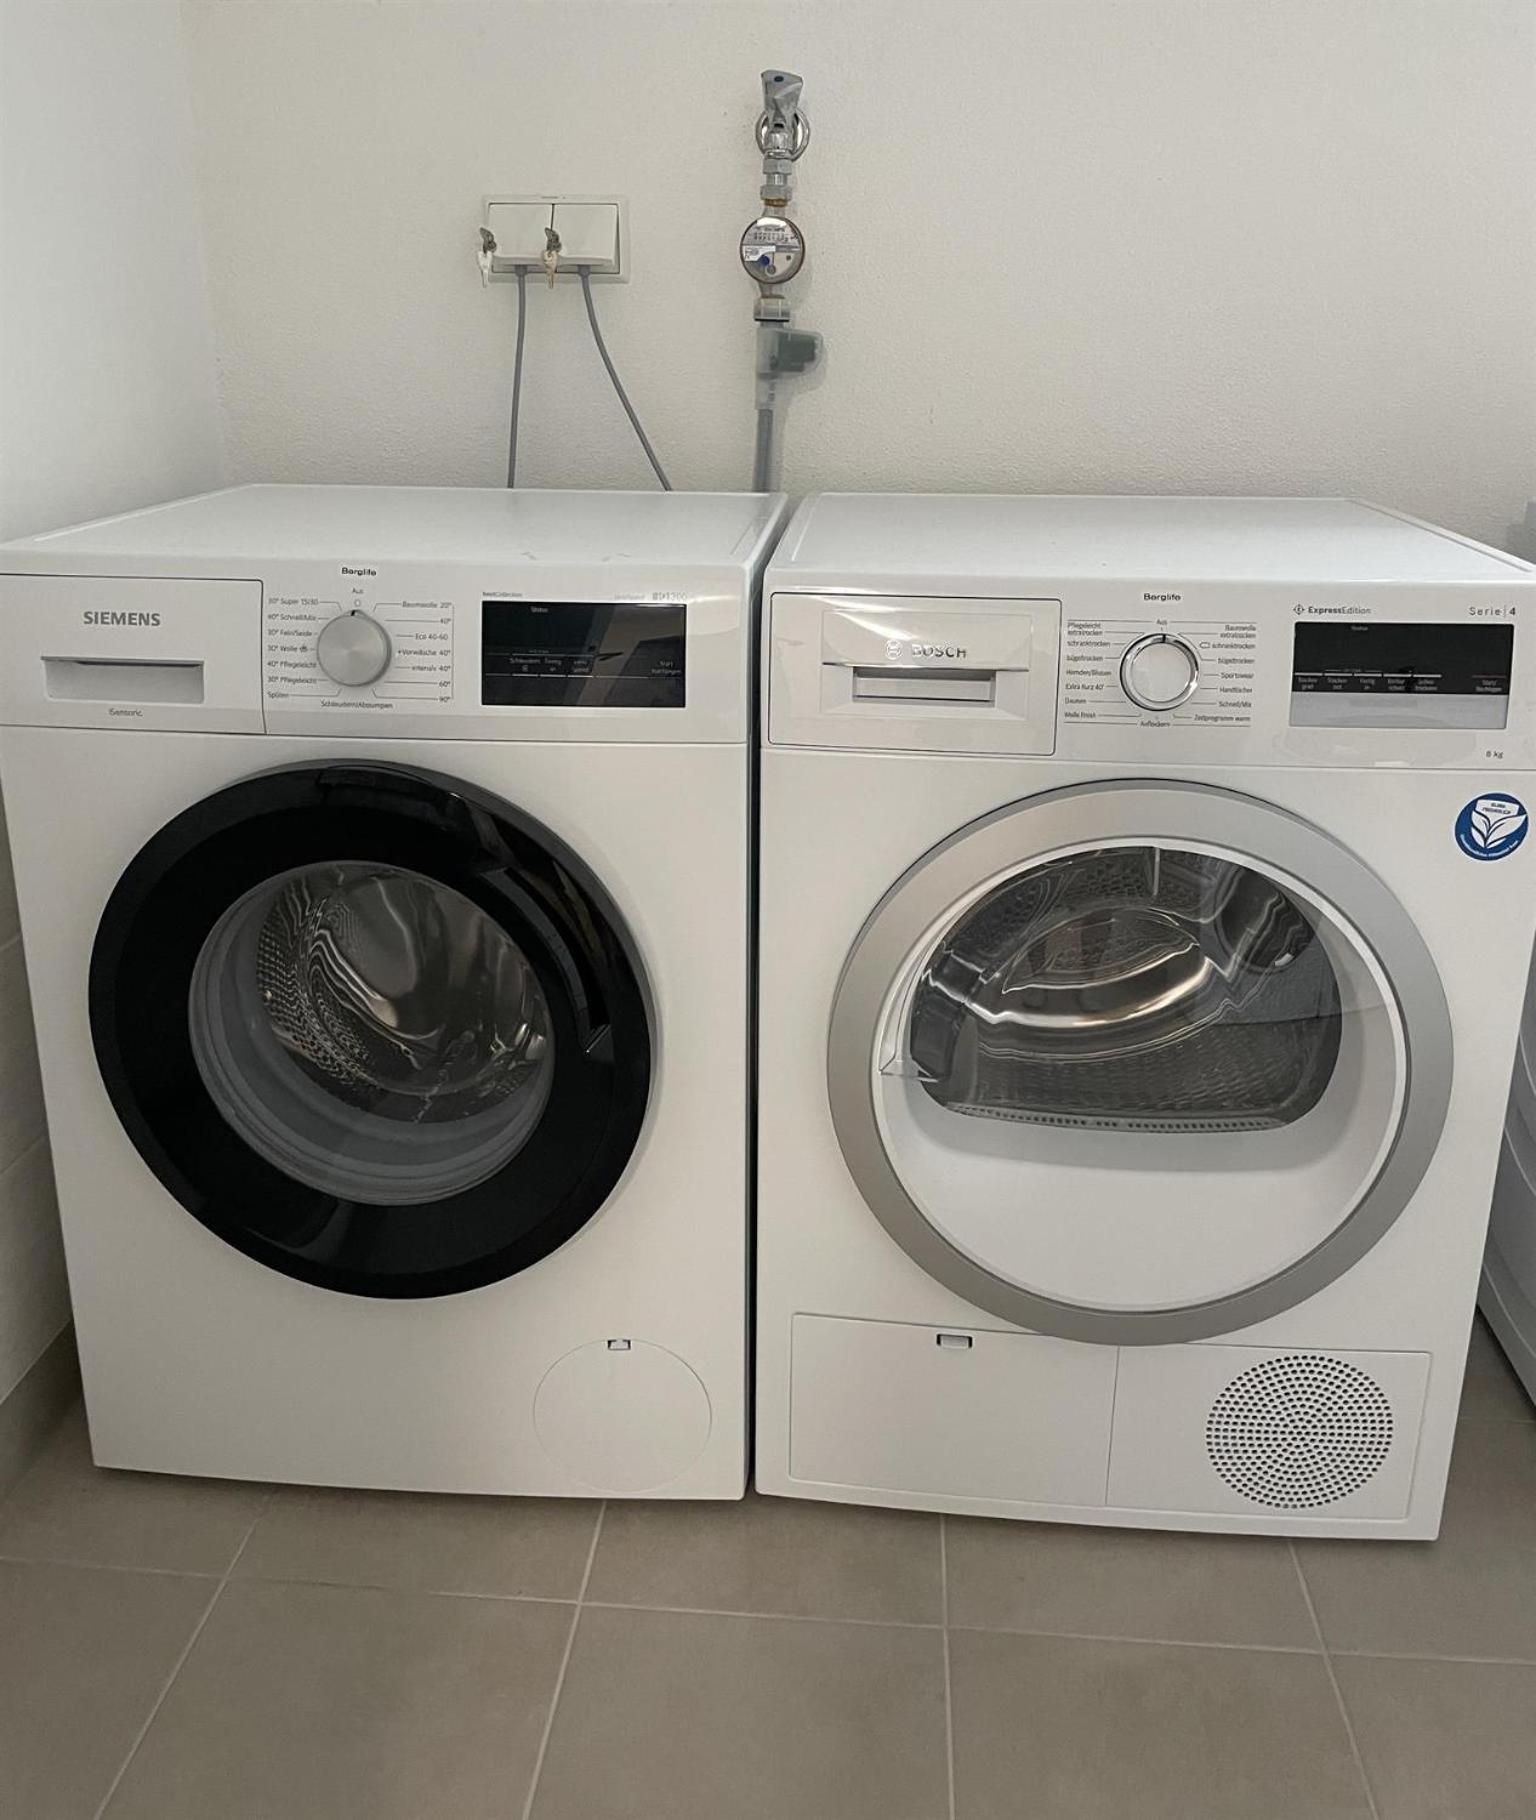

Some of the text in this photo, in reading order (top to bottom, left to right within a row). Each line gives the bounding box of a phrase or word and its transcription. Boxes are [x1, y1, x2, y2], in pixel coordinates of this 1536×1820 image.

[1308, 606, 1371, 615] ExpressEdition
[1469, 606, 1516, 616] Serie 4
[83, 611, 161, 626] SIEMENS
[911, 645, 967, 658] BOSCH
